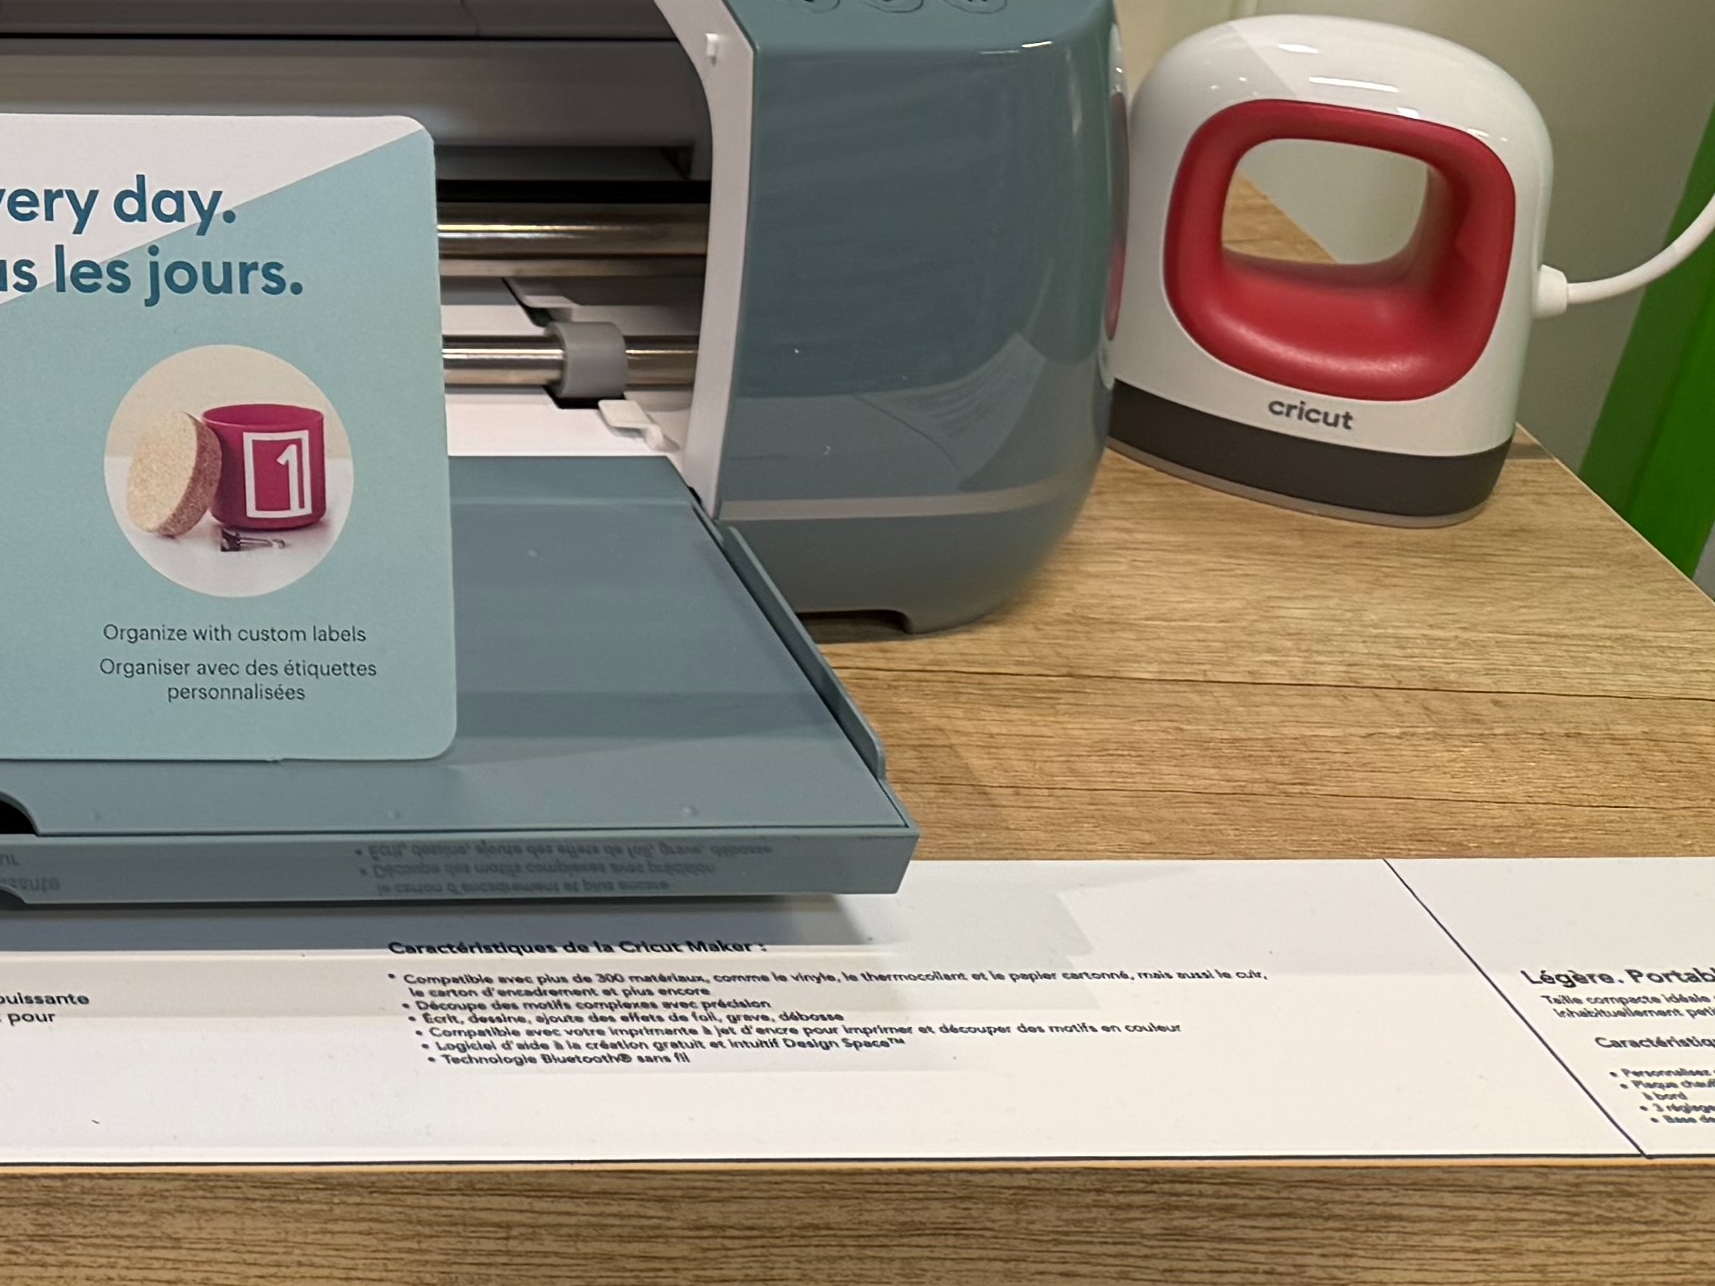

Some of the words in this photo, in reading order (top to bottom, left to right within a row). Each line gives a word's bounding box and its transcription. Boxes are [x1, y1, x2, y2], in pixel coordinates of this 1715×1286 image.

[113, 174, 237, 241] day.
[54, 245, 134, 296] les
[143, 245, 305, 308] jours.
[1268, 400, 1354, 431] cricut
[103, 623, 188, 645] Organize
[192, 624, 232, 642] with
[237, 627, 307, 642] custom
[312, 624, 367, 643] labels
[99, 658, 191, 679] Organiser
[196, 663, 240, 676] avec
[245, 659, 279, 677] des
[283, 659, 377, 680] étiquettes
[167, 683, 306, 703] personnalisées
[1520, 969, 1625, 989] Légère.
